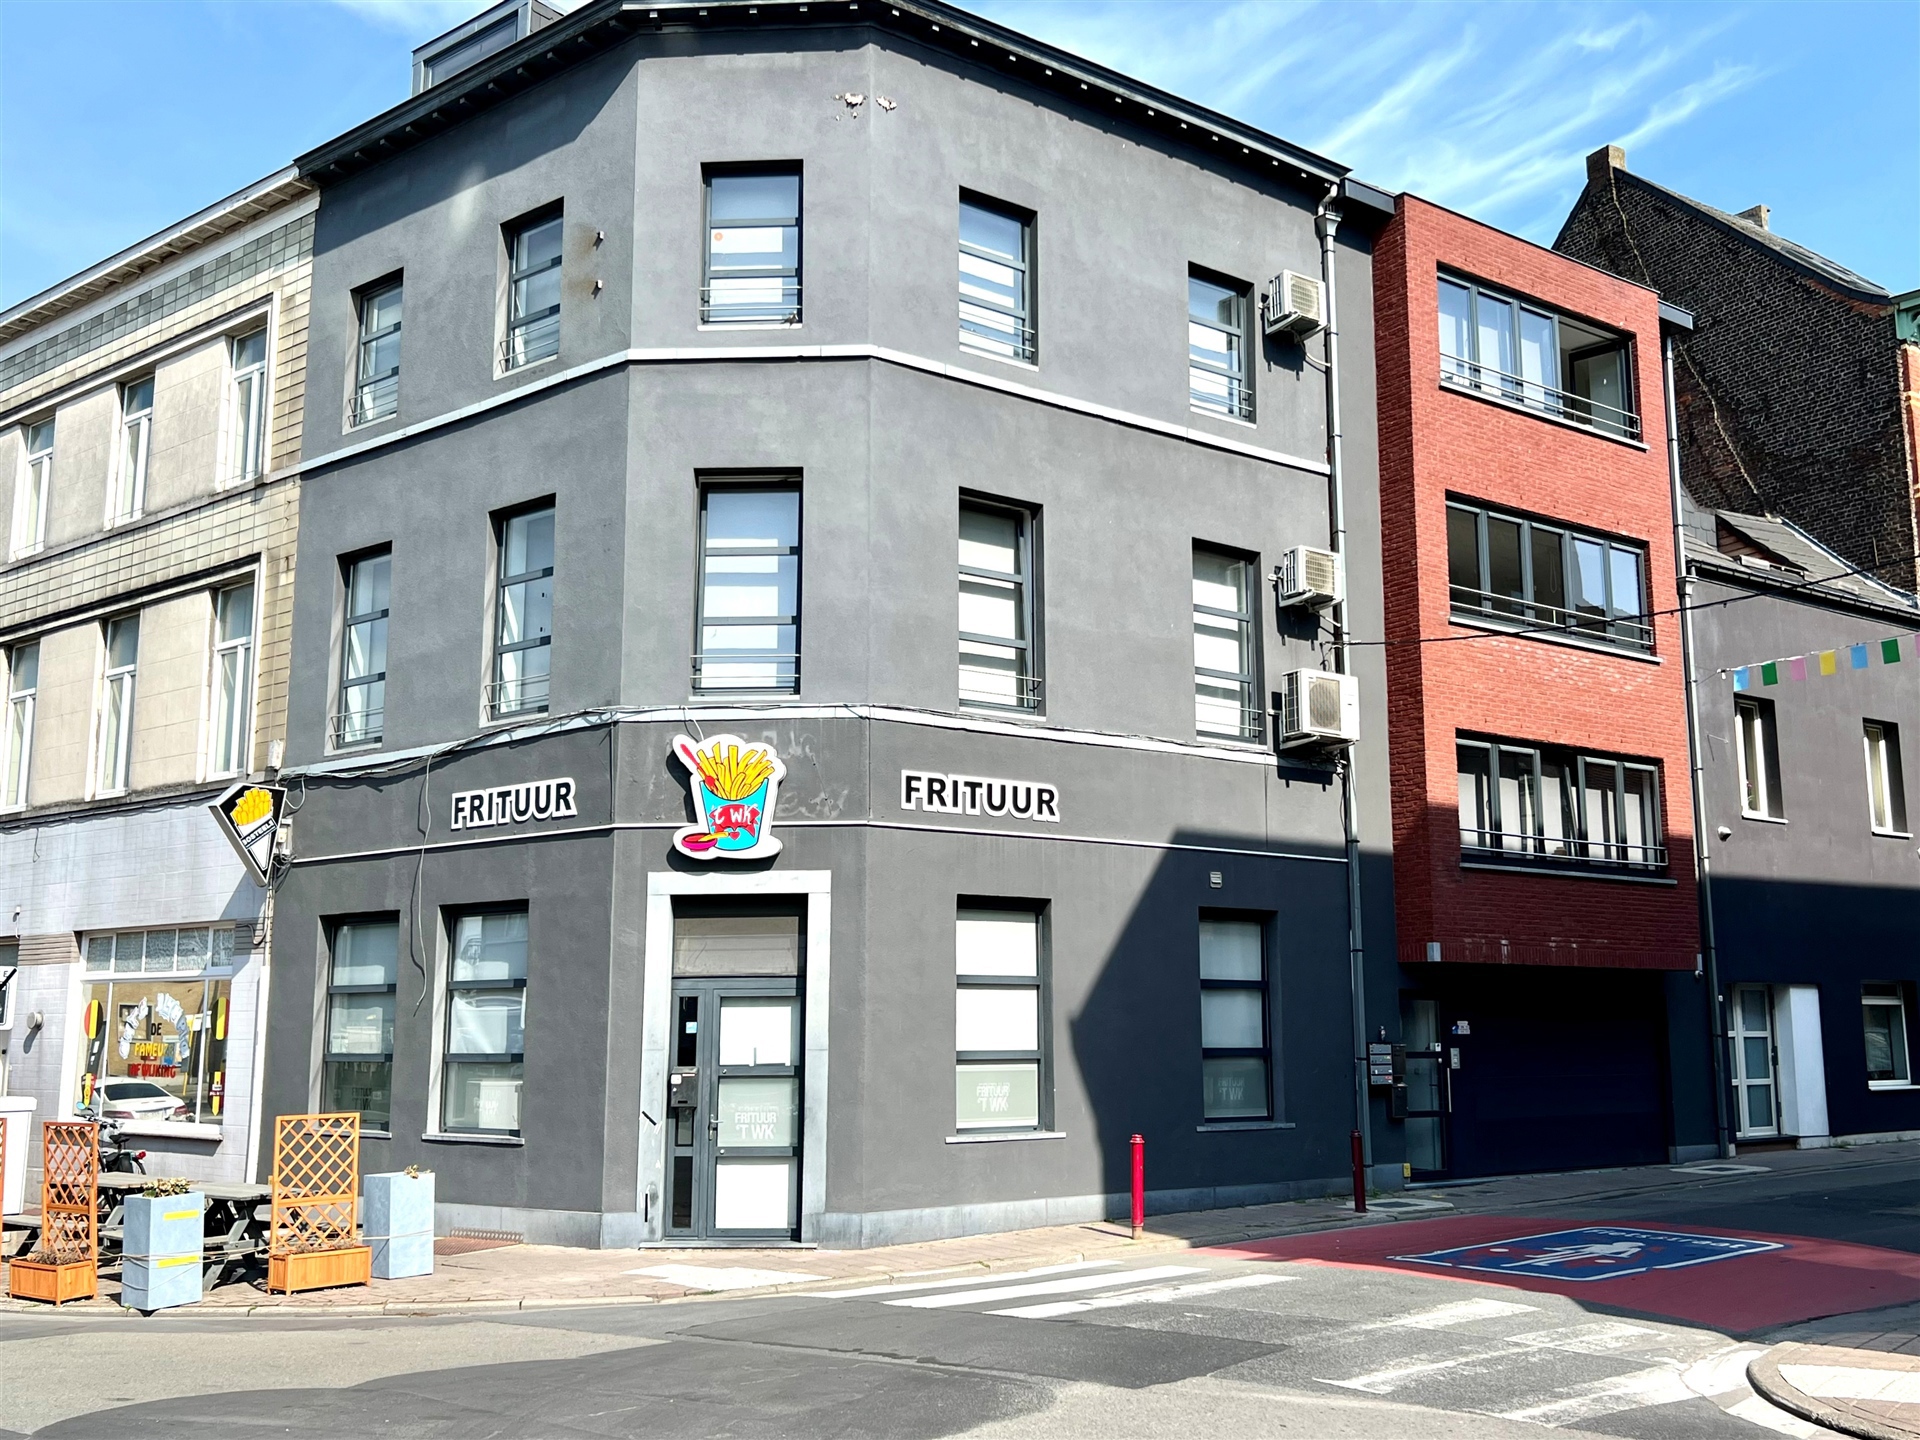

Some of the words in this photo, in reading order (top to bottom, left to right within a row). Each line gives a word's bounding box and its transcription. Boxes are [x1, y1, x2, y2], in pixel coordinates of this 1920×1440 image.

[453, 781, 573, 825] FRITUUR
[904, 774, 1057, 818] FRITUUR
[150, 1023, 162, 1036] DE
[989, 1097, 1009, 1112] WK
[734, 1112, 777, 1124] FRITUUR
[751, 1124, 776, 1139] WK
